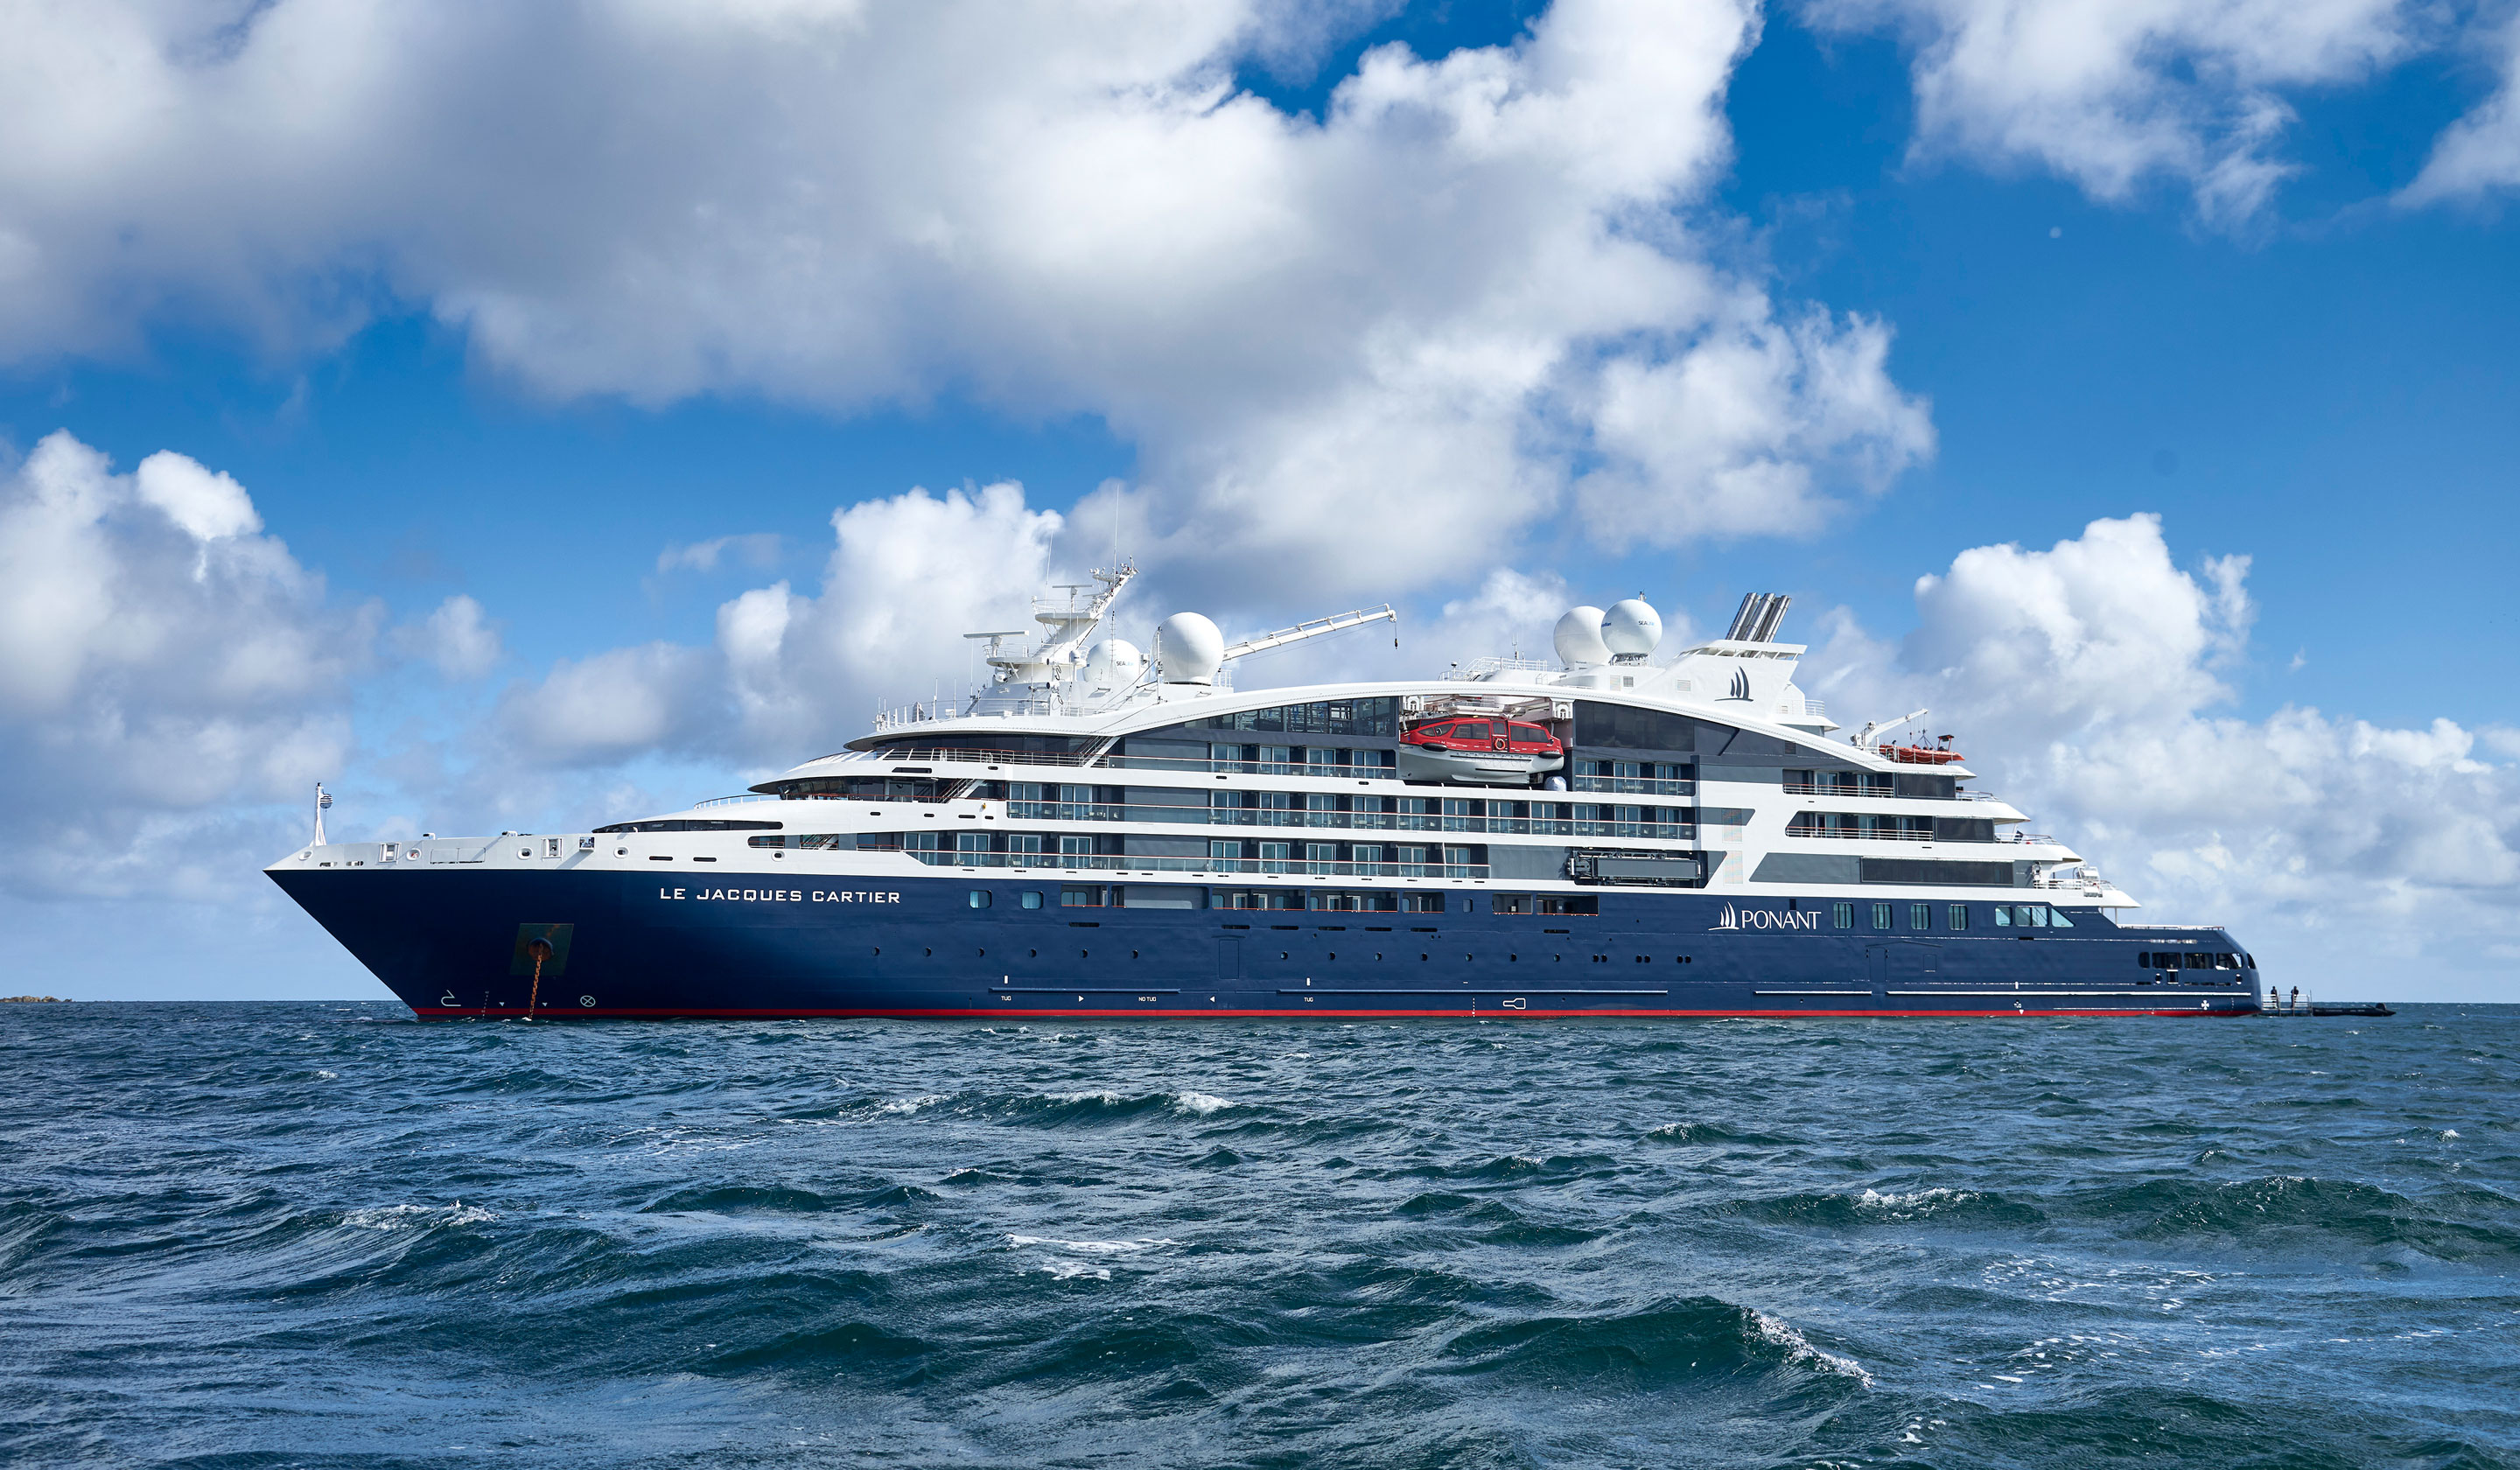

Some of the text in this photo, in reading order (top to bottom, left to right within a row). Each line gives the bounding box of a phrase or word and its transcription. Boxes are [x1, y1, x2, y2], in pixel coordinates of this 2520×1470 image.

[660, 887, 900, 904] LE JACQUES CARTIER
[1741, 910, 1822, 930] PONANT
